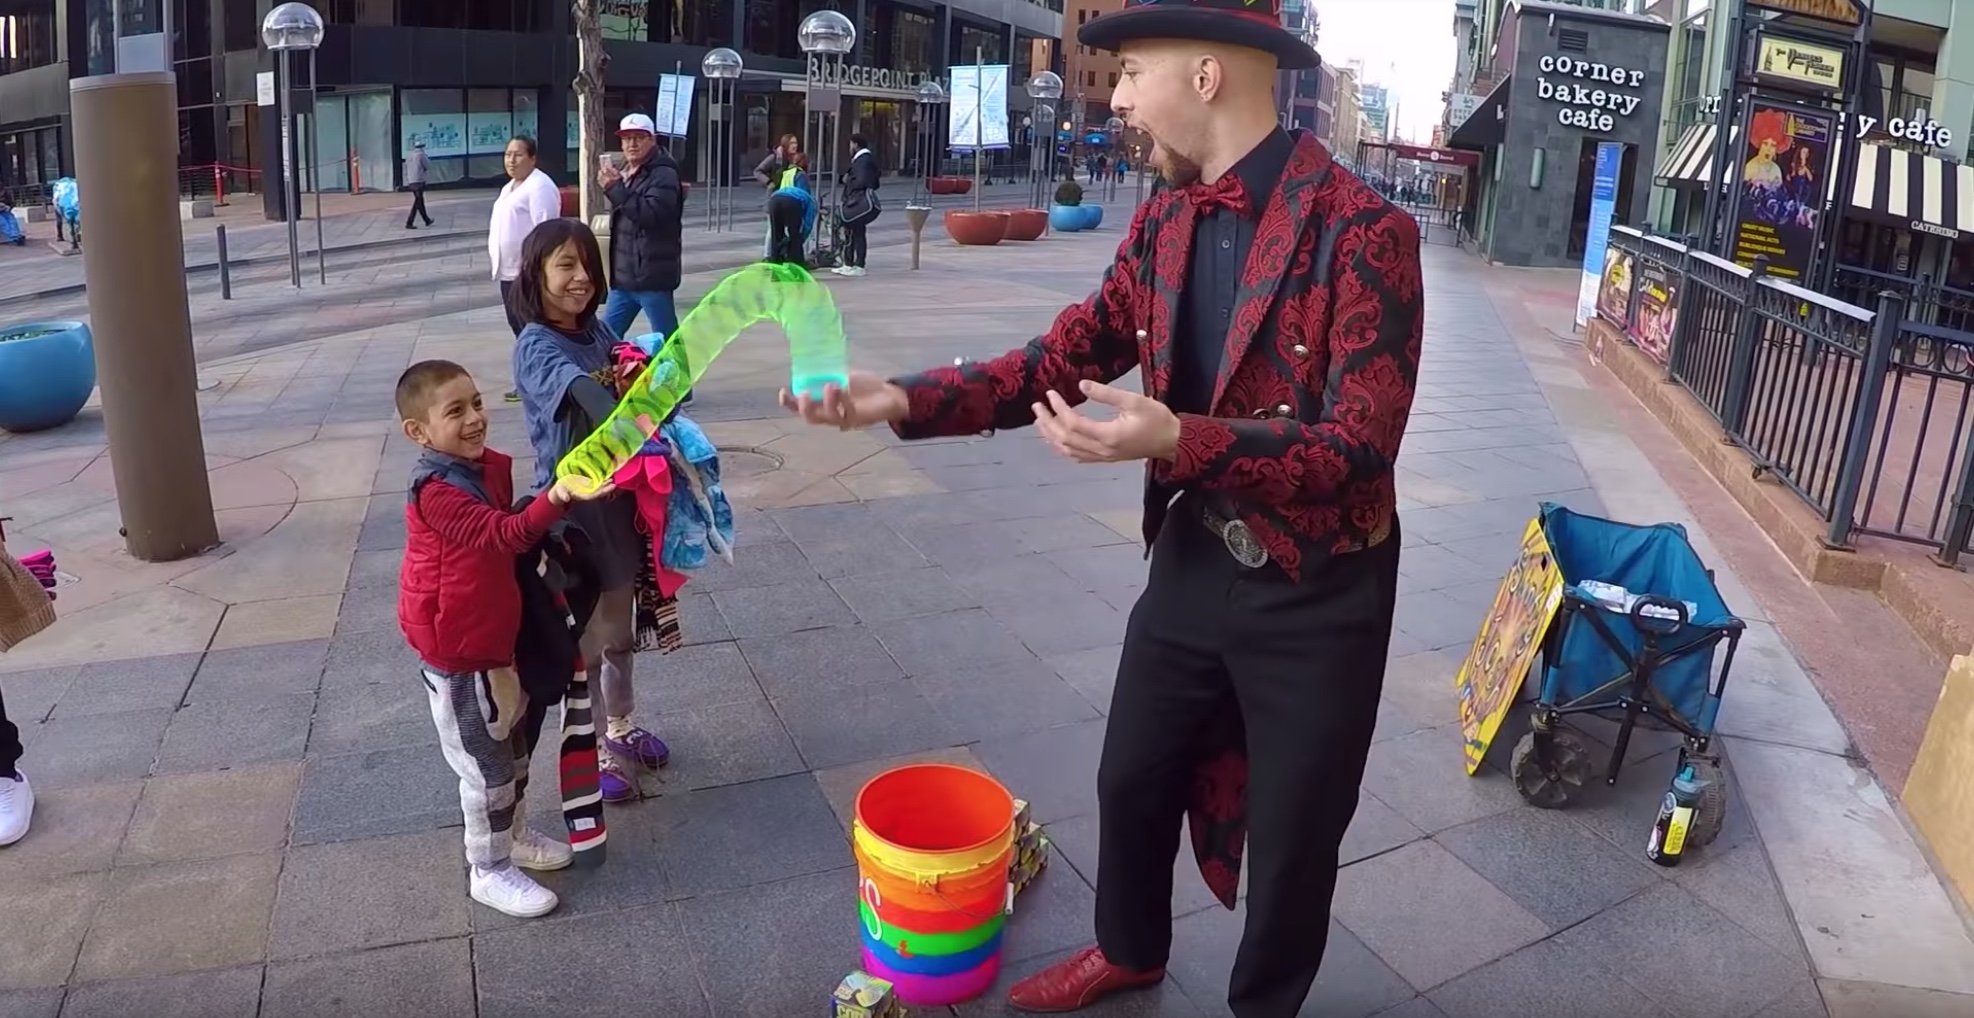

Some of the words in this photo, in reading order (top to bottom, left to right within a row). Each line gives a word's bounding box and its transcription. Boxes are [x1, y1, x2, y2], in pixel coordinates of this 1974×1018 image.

[1540, 55, 1645, 87] corner
[1537, 77, 1641, 116] bakery
[1558, 108, 1614, 132] cafe
[1888, 116, 1952, 148] cafe
